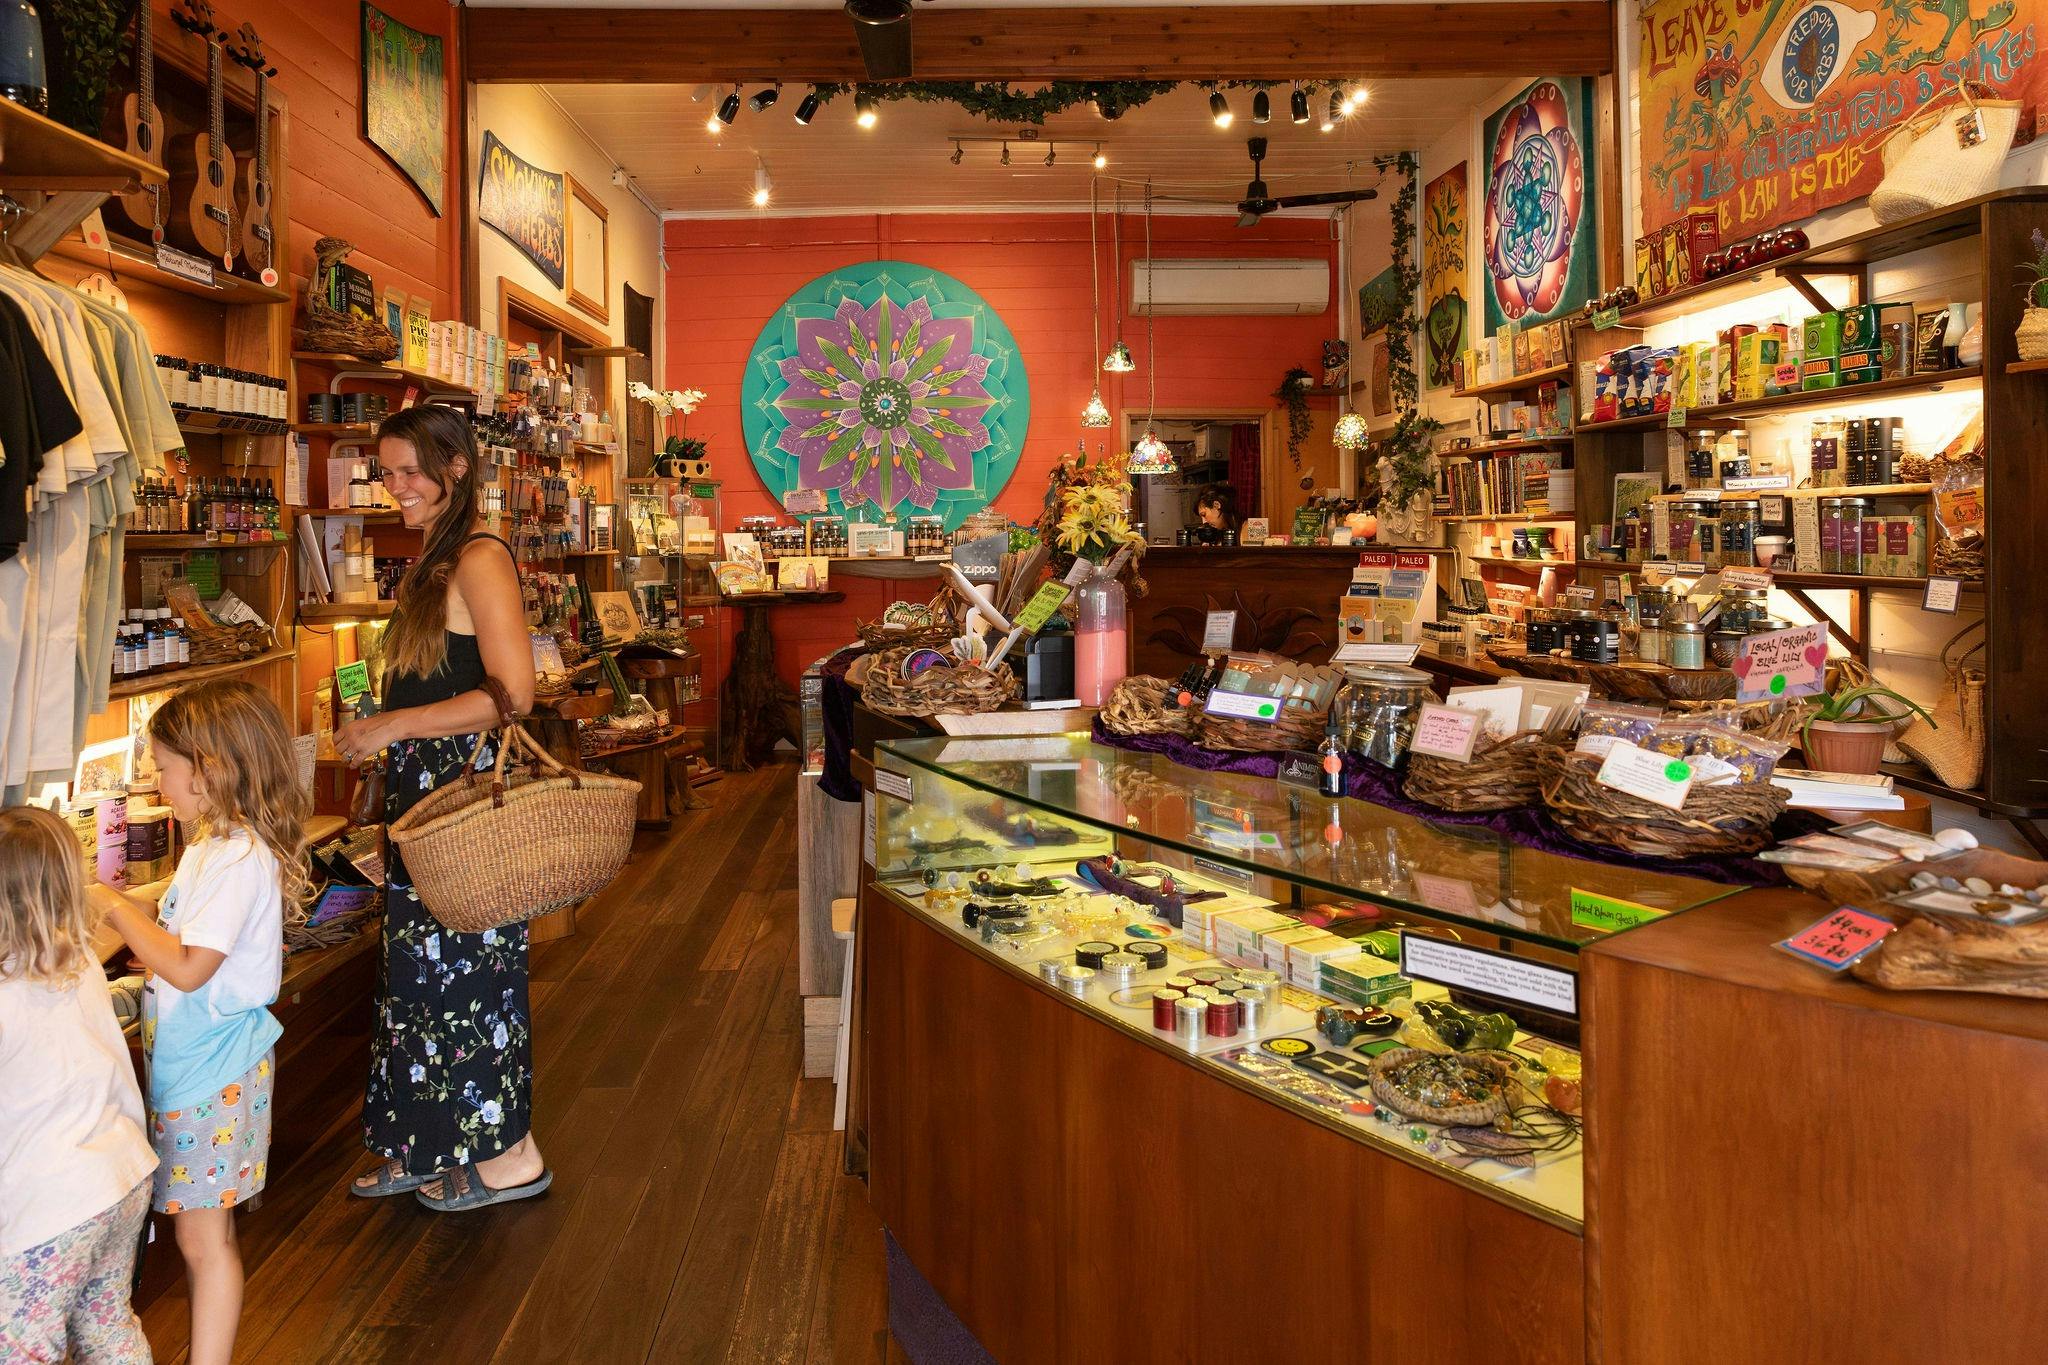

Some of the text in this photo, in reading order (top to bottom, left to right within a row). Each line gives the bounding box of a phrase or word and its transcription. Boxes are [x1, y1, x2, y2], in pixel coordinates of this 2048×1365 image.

[1784, 65, 1809, 99] FOR
[1738, 175, 1779, 225] LAW
[1815, 141, 1865, 192] THE
[409, 324, 429, 338] PIG
[1364, 555, 1387, 563] PALEO
[1401, 556, 1424, 565] PALEO
[963, 563, 997, 577] zippo
[1574, 900, 1592, 914] Hand
[1594, 907, 1614, 920] Blown
[1615, 912, 1635, 926] Glass
[1527, 969, 1542, 979] glass
